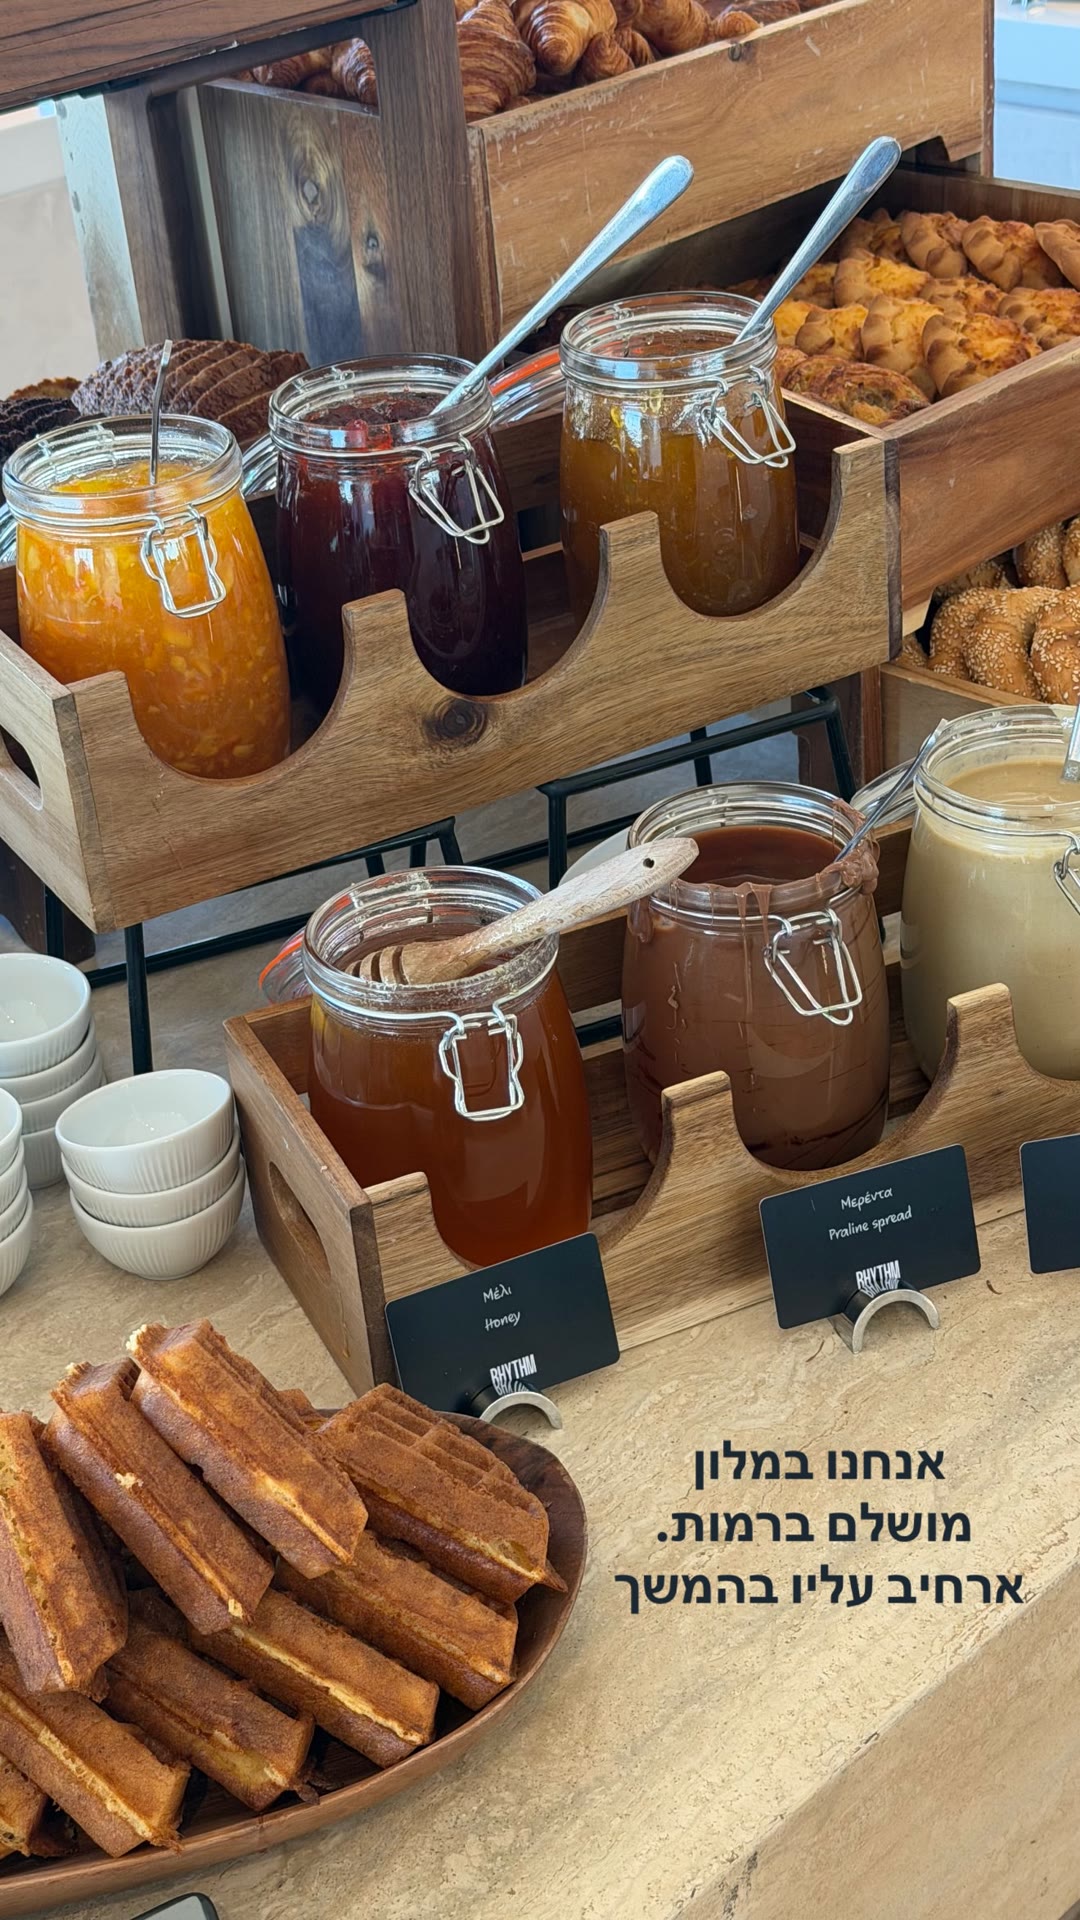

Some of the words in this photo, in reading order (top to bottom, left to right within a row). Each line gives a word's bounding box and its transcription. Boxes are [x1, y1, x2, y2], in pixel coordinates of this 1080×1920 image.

[840, 1187, 893, 1212] Μερέντα
[828, 1221, 870, 1241] Praline
[872, 1205, 913, 1233] spread
[856, 1259, 901, 1290] RHYTHM
[482, 1283, 512, 1303] Μέλι
[484, 1311, 521, 1332] Honey
[489, 1353, 537, 1383] RHYTHM
